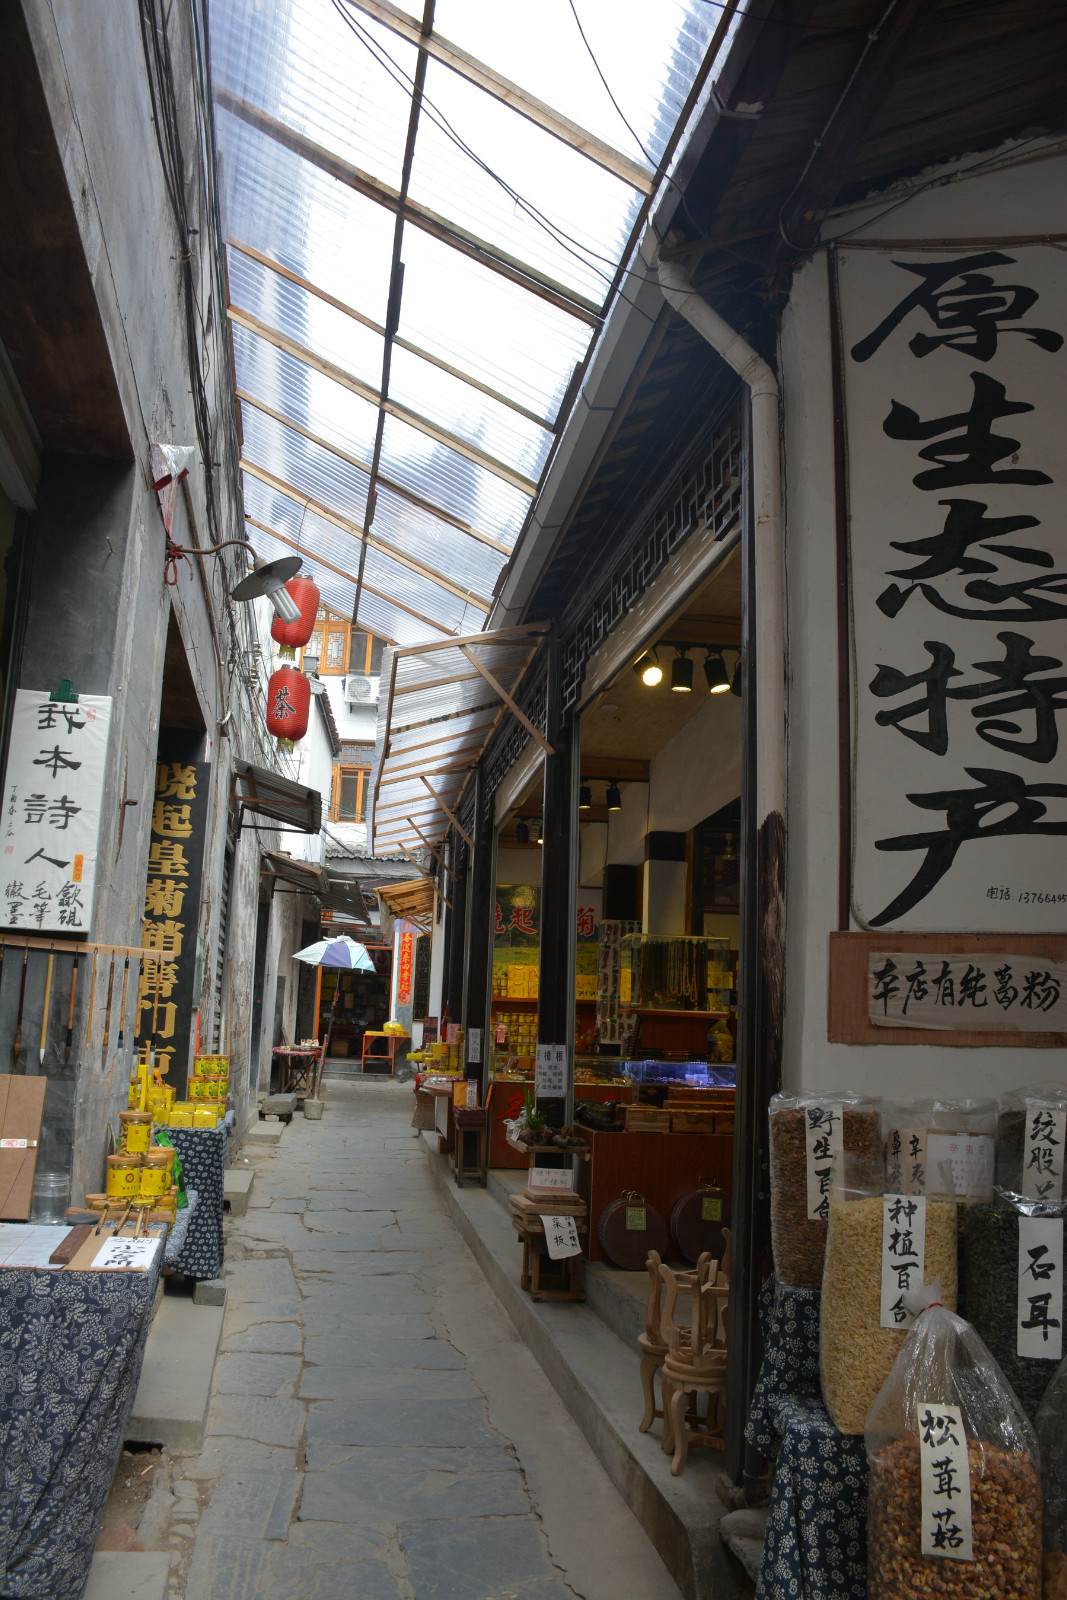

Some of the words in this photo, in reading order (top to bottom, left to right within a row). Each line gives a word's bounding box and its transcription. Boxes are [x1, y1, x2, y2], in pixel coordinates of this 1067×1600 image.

[850, 251, 1067, 927] 原生态特产
[271, 686, 296, 720] 茶
[807, 1107, 840, 1219] 野生百合
[888, 1198, 919, 1323] 种植百合
[1021, 1245, 1060, 1341] 石耳
[920, 1410, 964, 1549] 松茸菇
